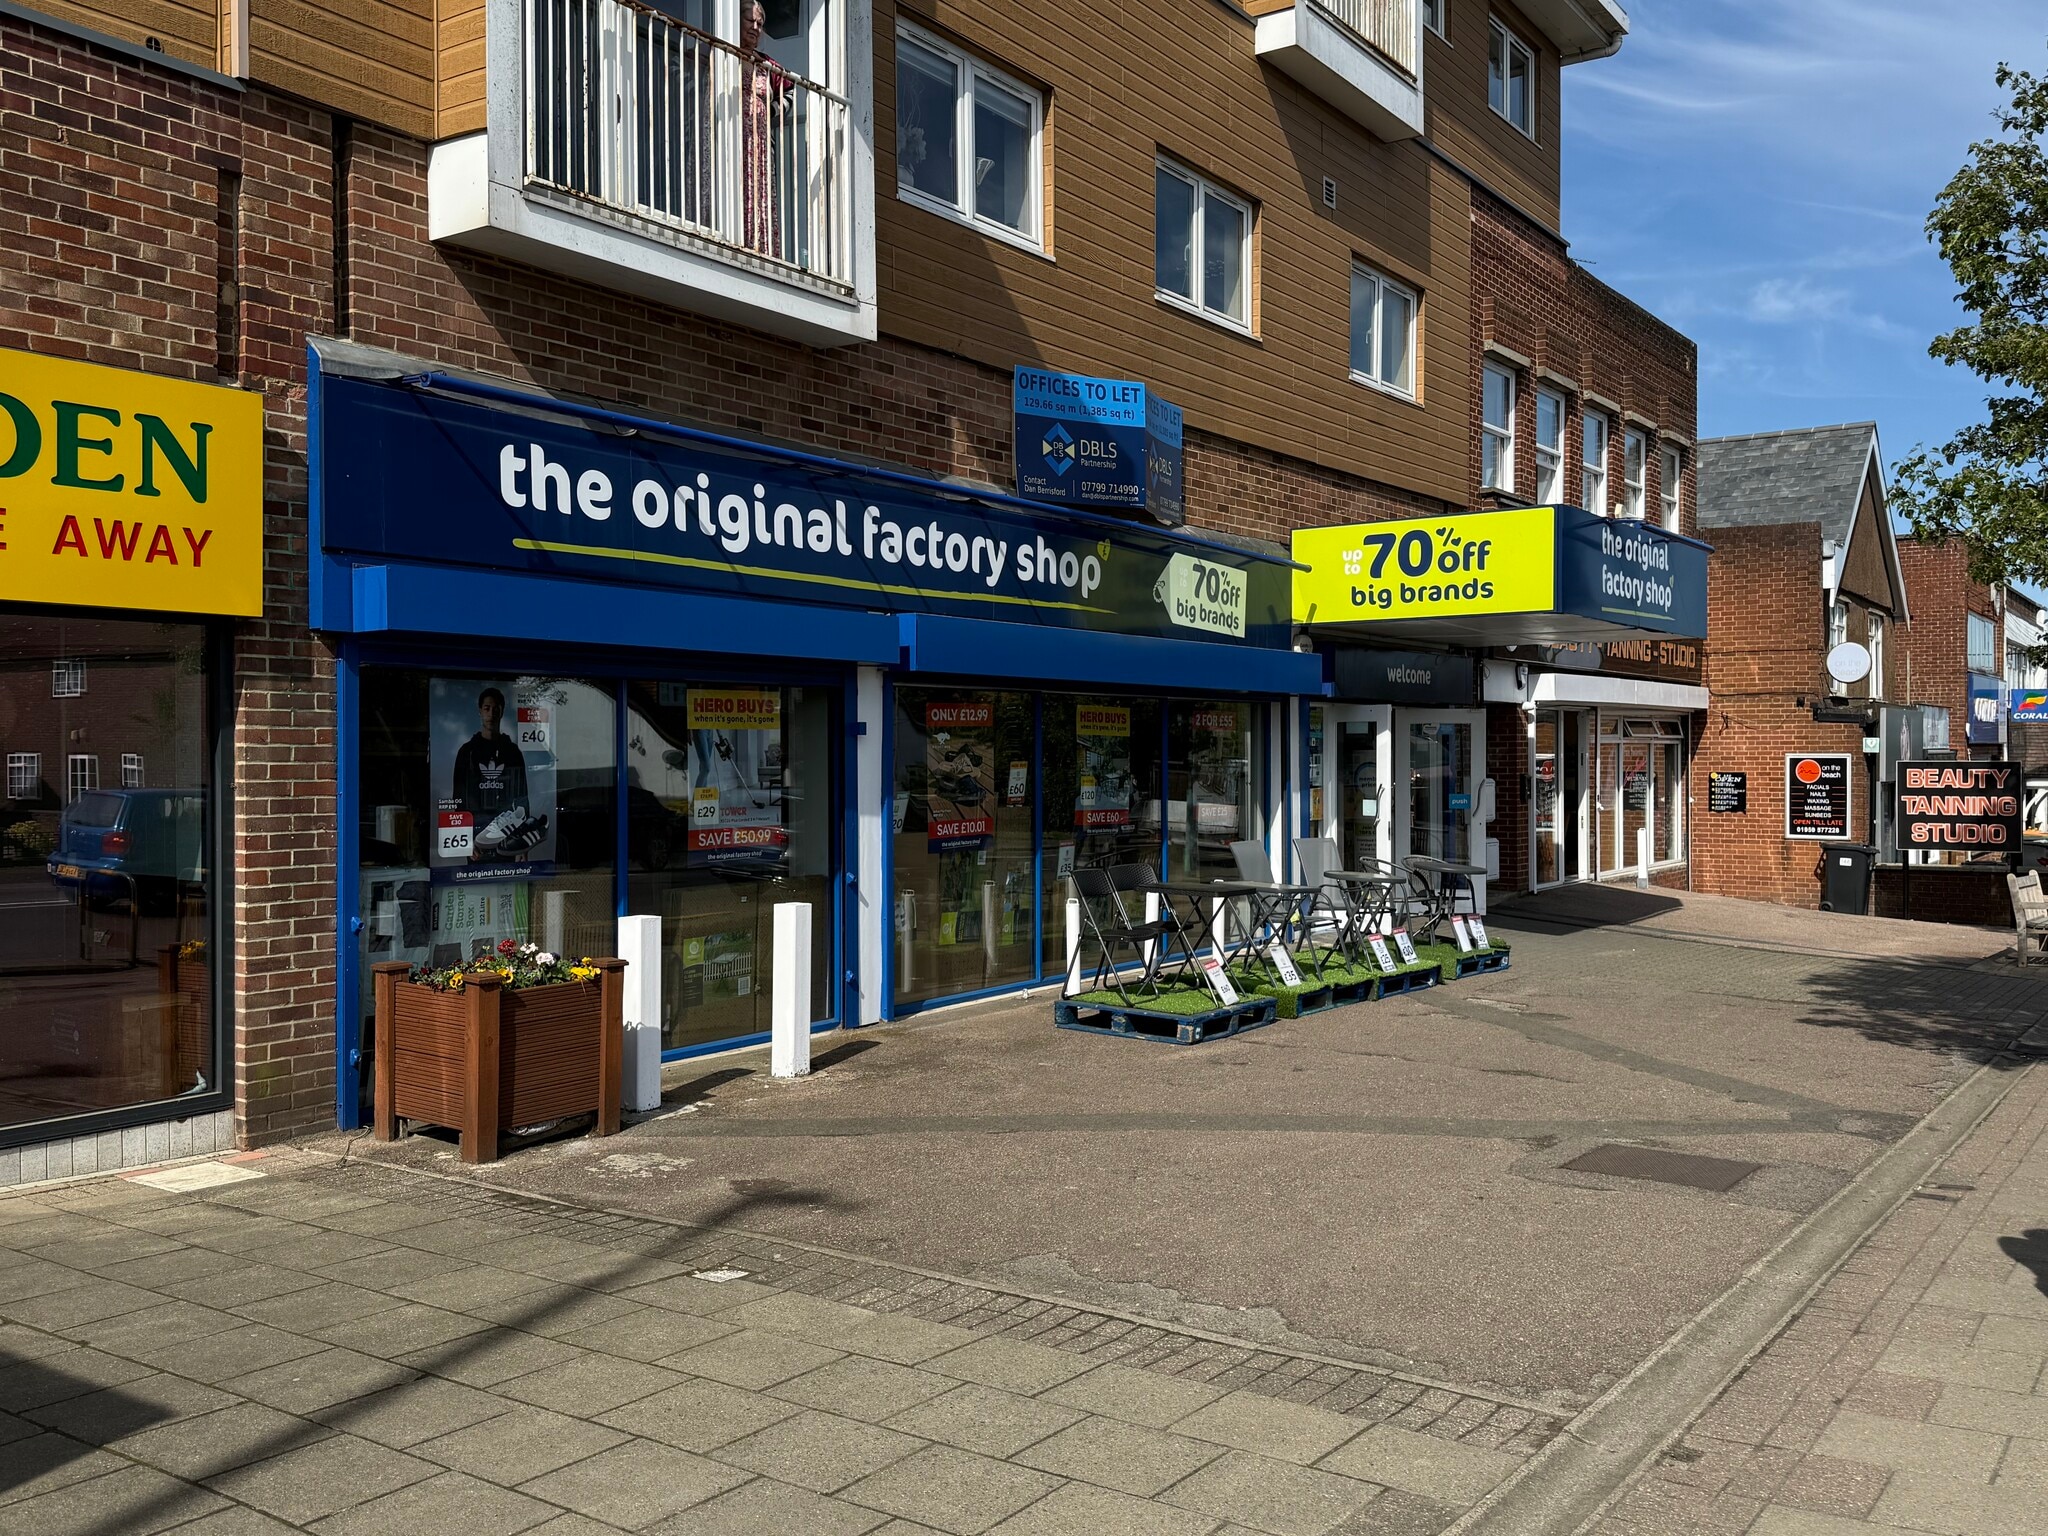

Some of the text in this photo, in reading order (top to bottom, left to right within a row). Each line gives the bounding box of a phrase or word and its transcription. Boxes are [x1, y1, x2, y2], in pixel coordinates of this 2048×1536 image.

[1019, 372, 1141, 404] OFFICES TO LET
[1024, 396, 1135, 421] 129.66 sq m (1,385 sq ft)
[1080, 439, 1118, 459] DBLS
[1080, 457, 1117, 470] Partnership
[1023, 474, 1047, 486] Contact
[1081, 481, 1139, 495] 07799 714990
[1024, 484, 1066, 497] Dan Berrisford
[500, 443, 1102, 599] the original factory shop
[52, 514, 213, 568] AWAY
[1602, 525, 1669, 572] the original
[1342, 548, 1363, 568] up
[1437, 540, 1492, 574] off
[1343, 562, 1362, 576] to
[1220, 585, 1241, 608] off
[1351, 578, 1495, 610] big brands
[1602, 563, 1672, 614] factory shop
[1176, 597, 1240, 630] big brands
[1659, 640, 1696, 668] STUDIO
[1387, 663, 1431, 685] welcome
[693, 697, 775, 714] HERO BUYS
[694, 714, 775, 724] when it's gone, it's gone
[931, 708, 989, 721] ONLY £12.99
[1080, 711, 1127, 724] HERO BUYS
[1195, 714, 1233, 727] 2 FOR £55
[2013, 712, 2048, 720] CORAL
[521, 730, 546, 743] £40
[479, 780, 504, 790] adidas
[1906, 768, 2011, 789] BEAUTY
[1009, 783, 1025, 795] £60
[1081, 790, 1095, 800] £120
[697, 806, 716, 818] £29
[1201, 807, 1217, 818] SAVE
[1901, 795, 2017, 816] TANNING
[1086, 811, 1120, 824] SAVE £60
[936, 820, 986, 836] SAVE £10.01
[1911, 822, 2007, 844] STUDIO
[443, 834, 468, 849] £65
[698, 829, 772, 847] SAVE £50.99
[456, 867, 531, 879] the original factory shop
[1060, 863, 1072, 873] £35
[445, 890, 454, 931] Garden
[456, 887, 467, 929] Storage
[466, 905, 475, 928] Box
[1284, 970, 1297, 982] £35
